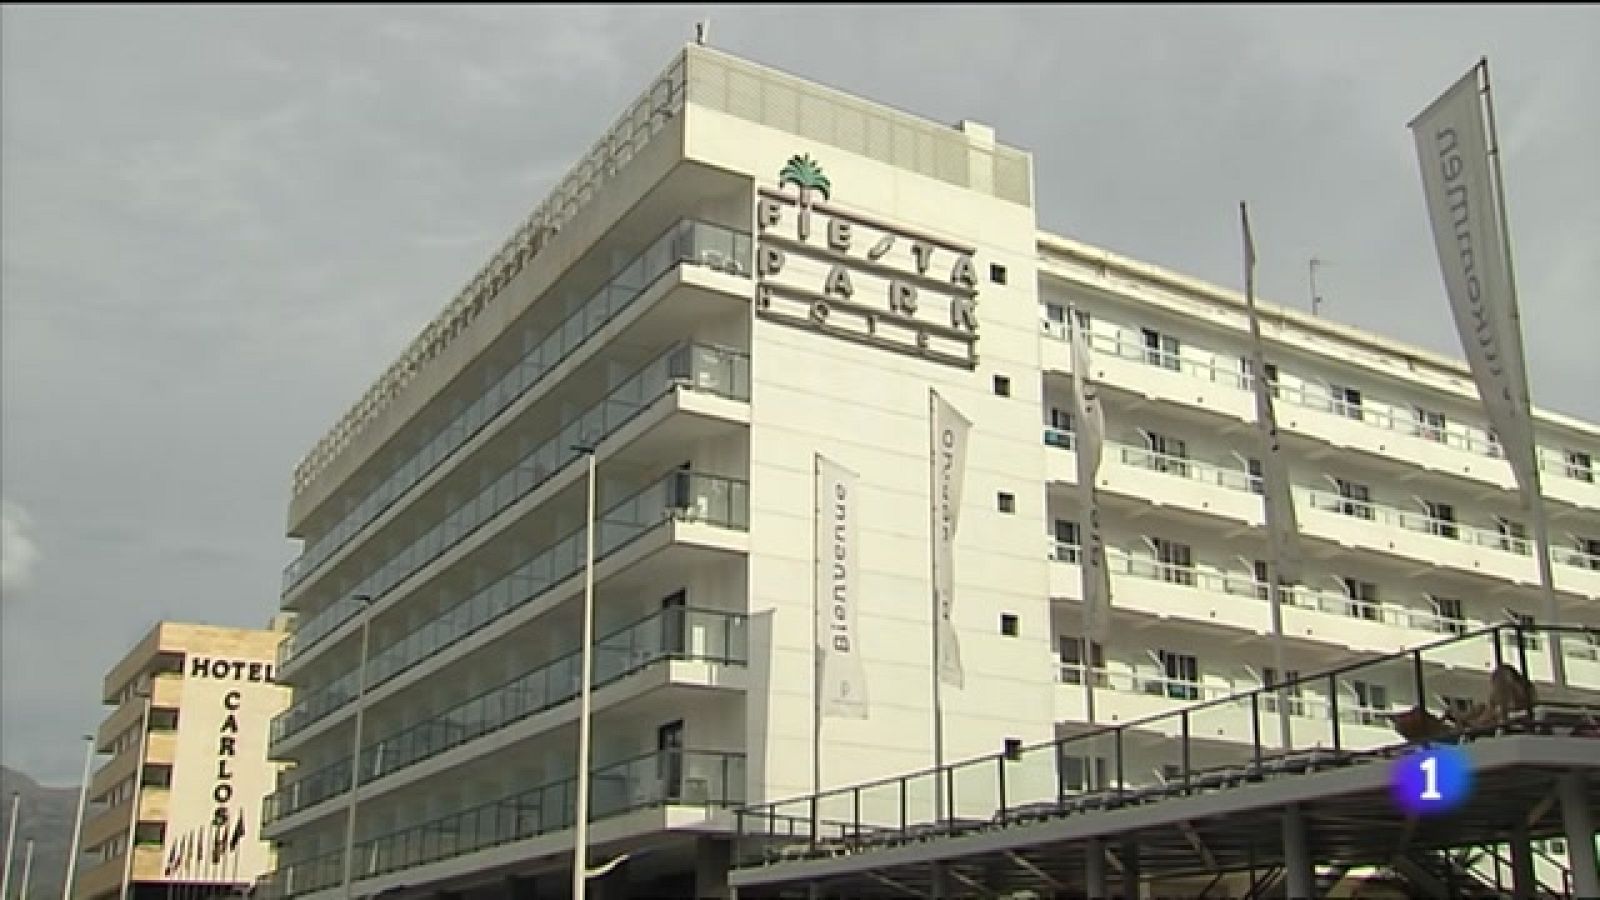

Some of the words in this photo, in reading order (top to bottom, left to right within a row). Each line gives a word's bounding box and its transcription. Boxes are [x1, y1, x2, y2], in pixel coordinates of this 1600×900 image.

[757, 199, 978, 288] FIESTA
[755, 284, 980, 371] HOTEL
[757, 245, 979, 332] PARK
[831, 482, 851, 654] Bienvenue
[191, 657, 275, 683] HOTEL
